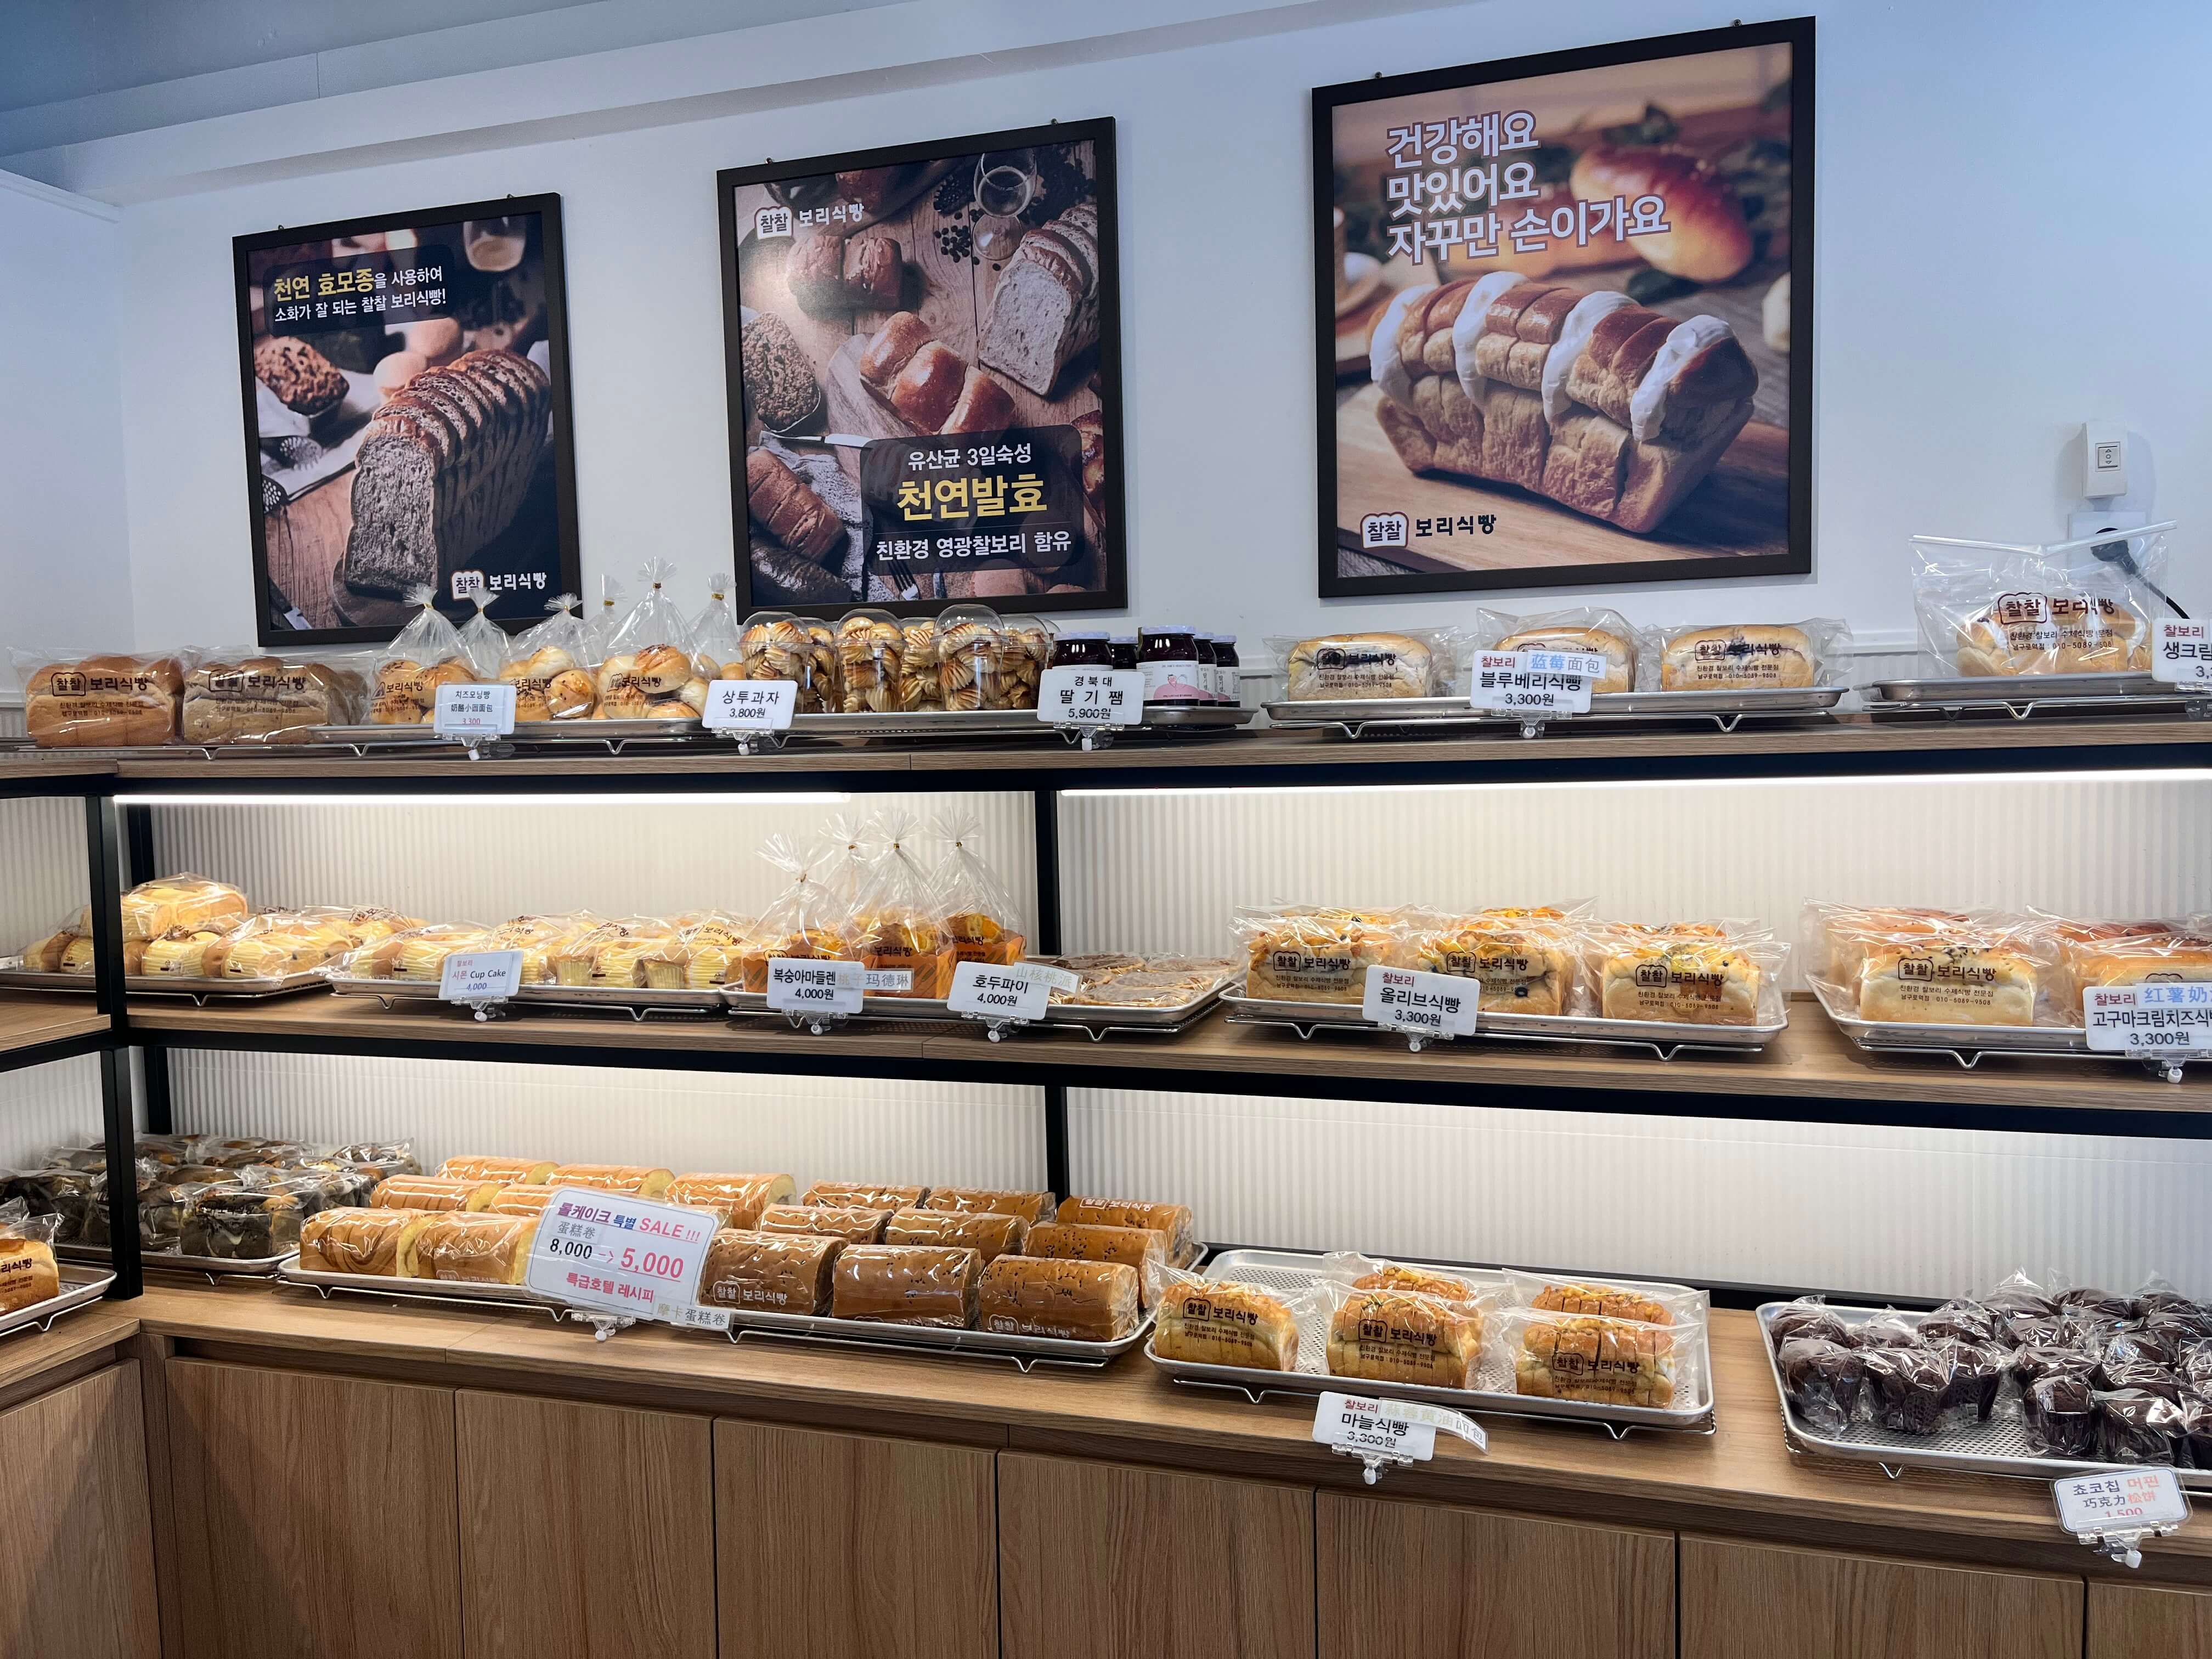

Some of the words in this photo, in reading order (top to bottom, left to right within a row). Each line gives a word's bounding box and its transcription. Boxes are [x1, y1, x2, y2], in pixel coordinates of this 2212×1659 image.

[1388, 111, 1539, 168] 건강해요
[1388, 164, 1539, 219] 맛있어요
[760, 213, 788, 233] 찰찰
[799, 203, 865, 228] 보리식빵
[1388, 212, 1498, 264] 자꾸만
[1510, 195, 1671, 253] 손이가요
[274, 276, 309, 302] 천연
[318, 268, 387, 296] 효모종을
[391, 266, 442, 286] 사용하여
[275, 304, 311, 322] 소화가
[315, 302, 328, 318] 잘
[332, 300, 357, 315] 되는
[362, 295, 386, 312] 찰찰
[391, 289, 446, 308] 보리식빵!
[908, 450, 961, 471] 유산균
[968, 443, 1032, 466] 3일숙성
[897, 473, 1048, 521] 천연발효
[1367, 520, 1403, 542] 찰찰
[1415, 514, 1497, 538] 보리식빵
[876, 538, 930, 562] 친환경
[936, 534, 1028, 558] 영광찰보리
[1034, 531, 1072, 554] 함유
[489, 572, 546, 590] 보리식빵
[2006, 599, 2041, 617] 찰찰
[2163, 624, 2204, 639] 찰보리
[1481, 656, 1516, 668] 찰보리
[1531, 653, 1600, 674] 蓝莓面包
[57, 678, 81, 691] 찰찰
[90, 677, 149, 691] 보리식빵
[248, 675, 306, 690] 보리식빵
[1480, 671, 1582, 691] 블루베리식빵
[455, 690, 491, 700] 치즈모닝빵
[722, 690, 780, 705] 상투과자
[1505, 693, 1554, 706] 3,300원
[729, 708, 766, 719] 3,800원
[1068, 709, 1111, 720] 5,900원
[1277, 956, 1297, 967] 찰찰
[1304, 957, 1351, 970] 보리식빵
[1904, 963, 1928, 976] 찰찰
[1937, 965, 1997, 981] 보리식빵
[470, 971, 485, 980] Cup
[488, 969, 506, 978] Cake
[773, 968, 836, 986] 복숭아마들렌
[1016, 966, 1073, 988] 山核桃派
[1382, 972, 1415, 987] 찰보리
[1640, 969, 1663, 983] 찰찰
[1671, 972, 1724, 986] 보리식빵
[466, 983, 487, 991] 4,000
[973, 974, 1029, 994] 호두파이
[795, 989, 834, 1001] 4,000원
[977, 993, 1018, 1007] 4,000원
[1380, 986, 1462, 1013] 올리브식빵
[2094, 992, 2137, 1006] 찰보리
[2145, 985, 2212, 1003] 红薯奶
[1395, 1009, 1442, 1027] 3,300원
[2130, 1031, 2191, 1047] 3,300원
[557, 1201, 612, 1224] 롤케이크
[613, 1214, 637, 1231] 특별
[639, 1217, 685, 1238] SALE
[557, 1221, 596, 1239] 蛋糕卷
[550, 1238, 592, 1260] 8,000
[620, 1247, 684, 1279] 5,000
[566, 1272, 614, 1295] 특급호텔
[618, 1283, 654, 1304] 레시피
[717, 1286, 736, 1299] 찰찰
[743, 1289, 788, 1306] 보리식빵
[1188, 1302, 1207, 1316] 찰찰
[1213, 1306, 1259, 1325] 보리식빵
[1363, 1323, 1383, 1338] 찰찰
[1390, 1328, 1437, 1347] 보리식빵
[1557, 1357, 1579, 1371] 찰찰
[1344, 1399, 1379, 1414] 찰보리
[1341, 1413, 1409, 1437] 마늘식빵
[1347, 1431, 1397, 1449] 3,300원
[2126, 1474, 2160, 1489] 머핀
[2083, 1490, 2157, 1509] 巧克力松饼
